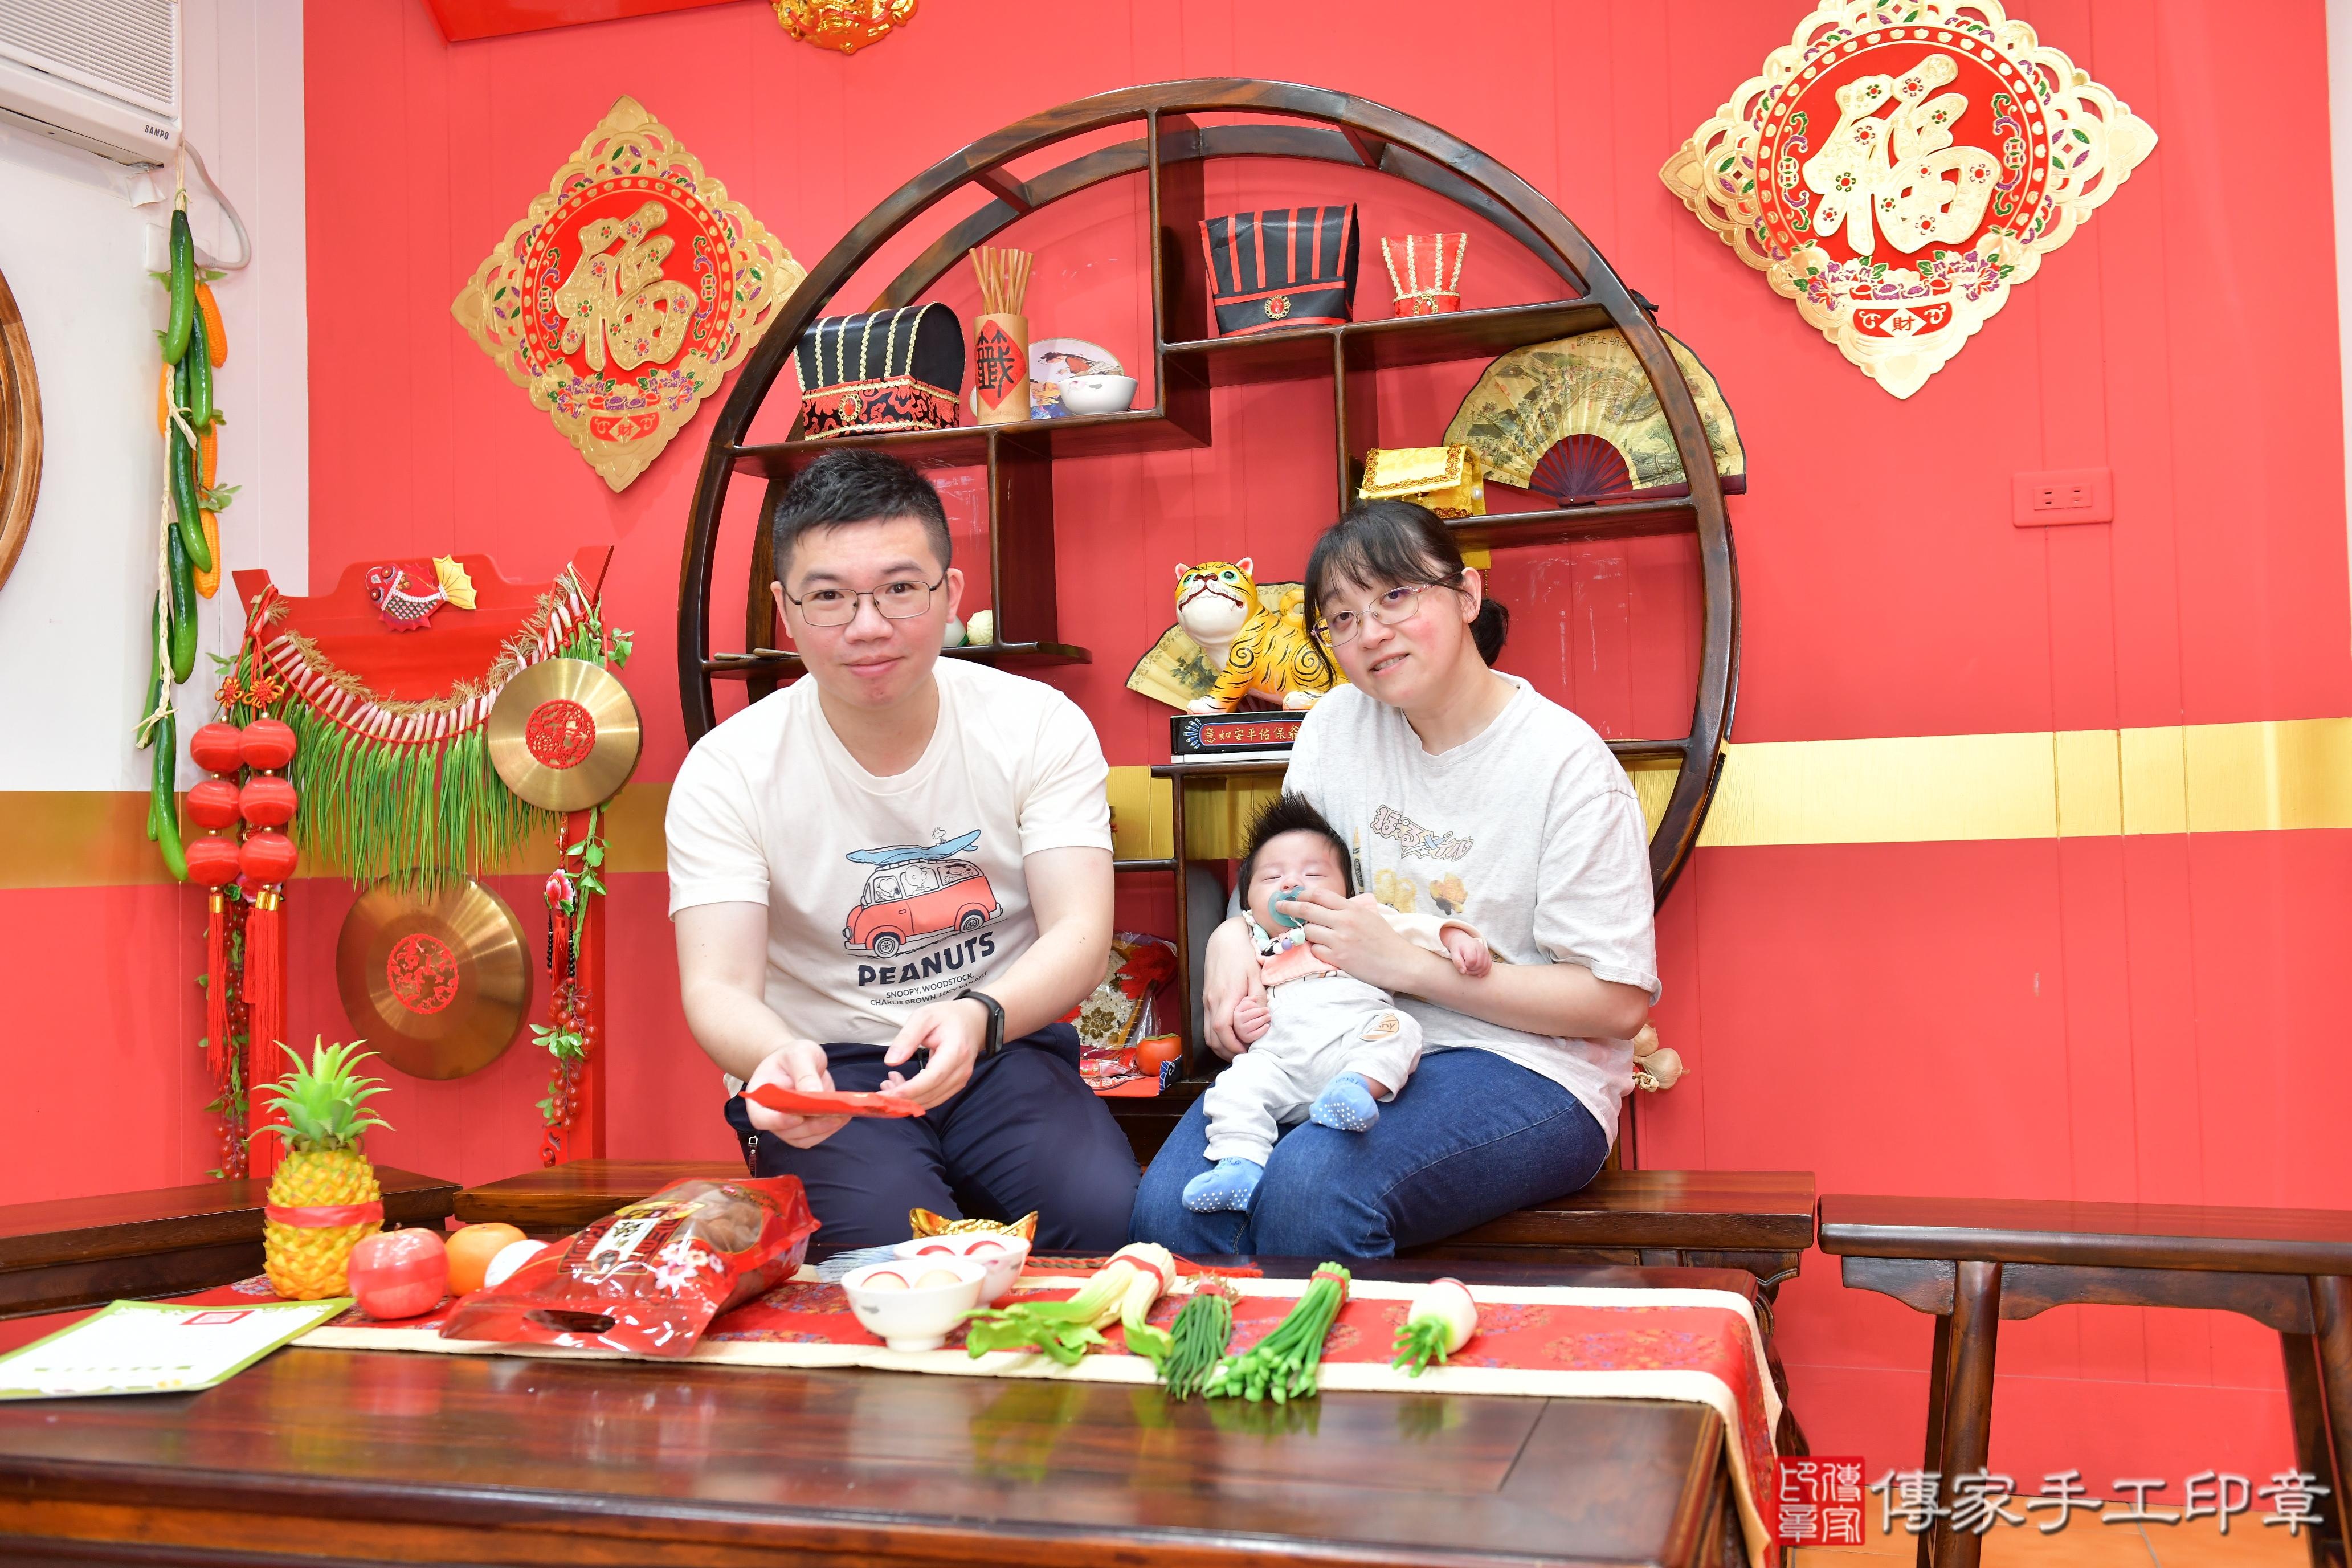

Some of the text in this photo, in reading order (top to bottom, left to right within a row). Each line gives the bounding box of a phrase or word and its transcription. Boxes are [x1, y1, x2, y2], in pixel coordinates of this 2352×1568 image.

[145, 125, 169, 140] SAMPO
[1803, 53, 2002, 254] 福
[554, 200, 699, 371] 福
[1892, 316, 1915, 332] 財
[617, 424, 634, 437] 財
[858, 931, 995, 986] PEANUTS
[886, 987, 921, 998] SNOOPY,
[938, 987, 958, 997] LUCY
[959, 980, 973, 990] VAN
[974, 970, 988, 982] PELT
